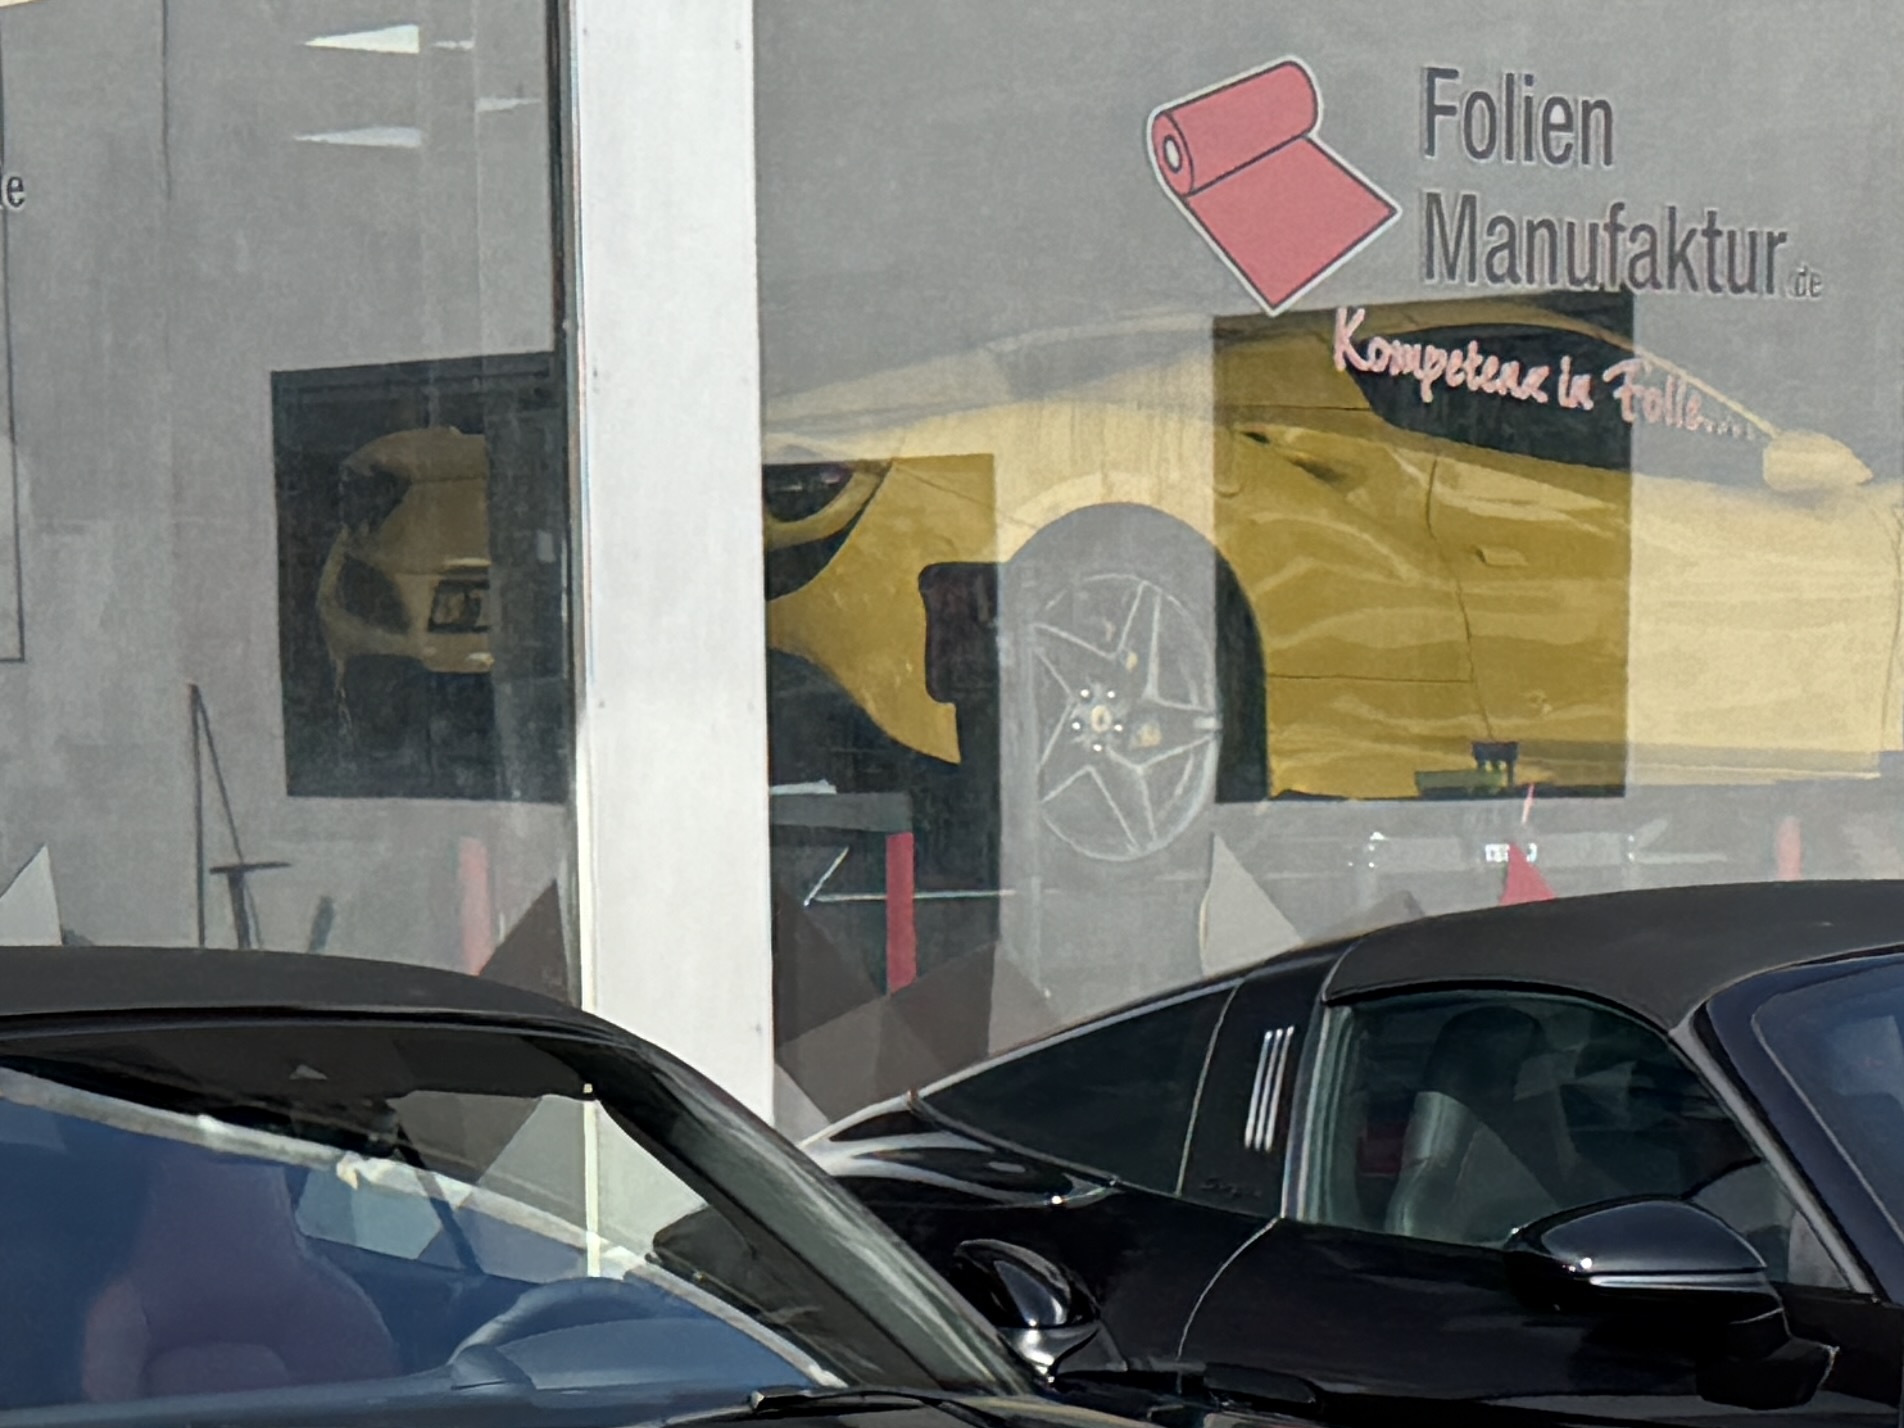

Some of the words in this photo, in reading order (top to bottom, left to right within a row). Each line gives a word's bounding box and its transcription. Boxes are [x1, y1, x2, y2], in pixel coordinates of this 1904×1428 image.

[1424, 66, 1614, 167] Folien
[1334, 306, 1550, 403] Kompetenz
[1558, 354, 1594, 411] in
